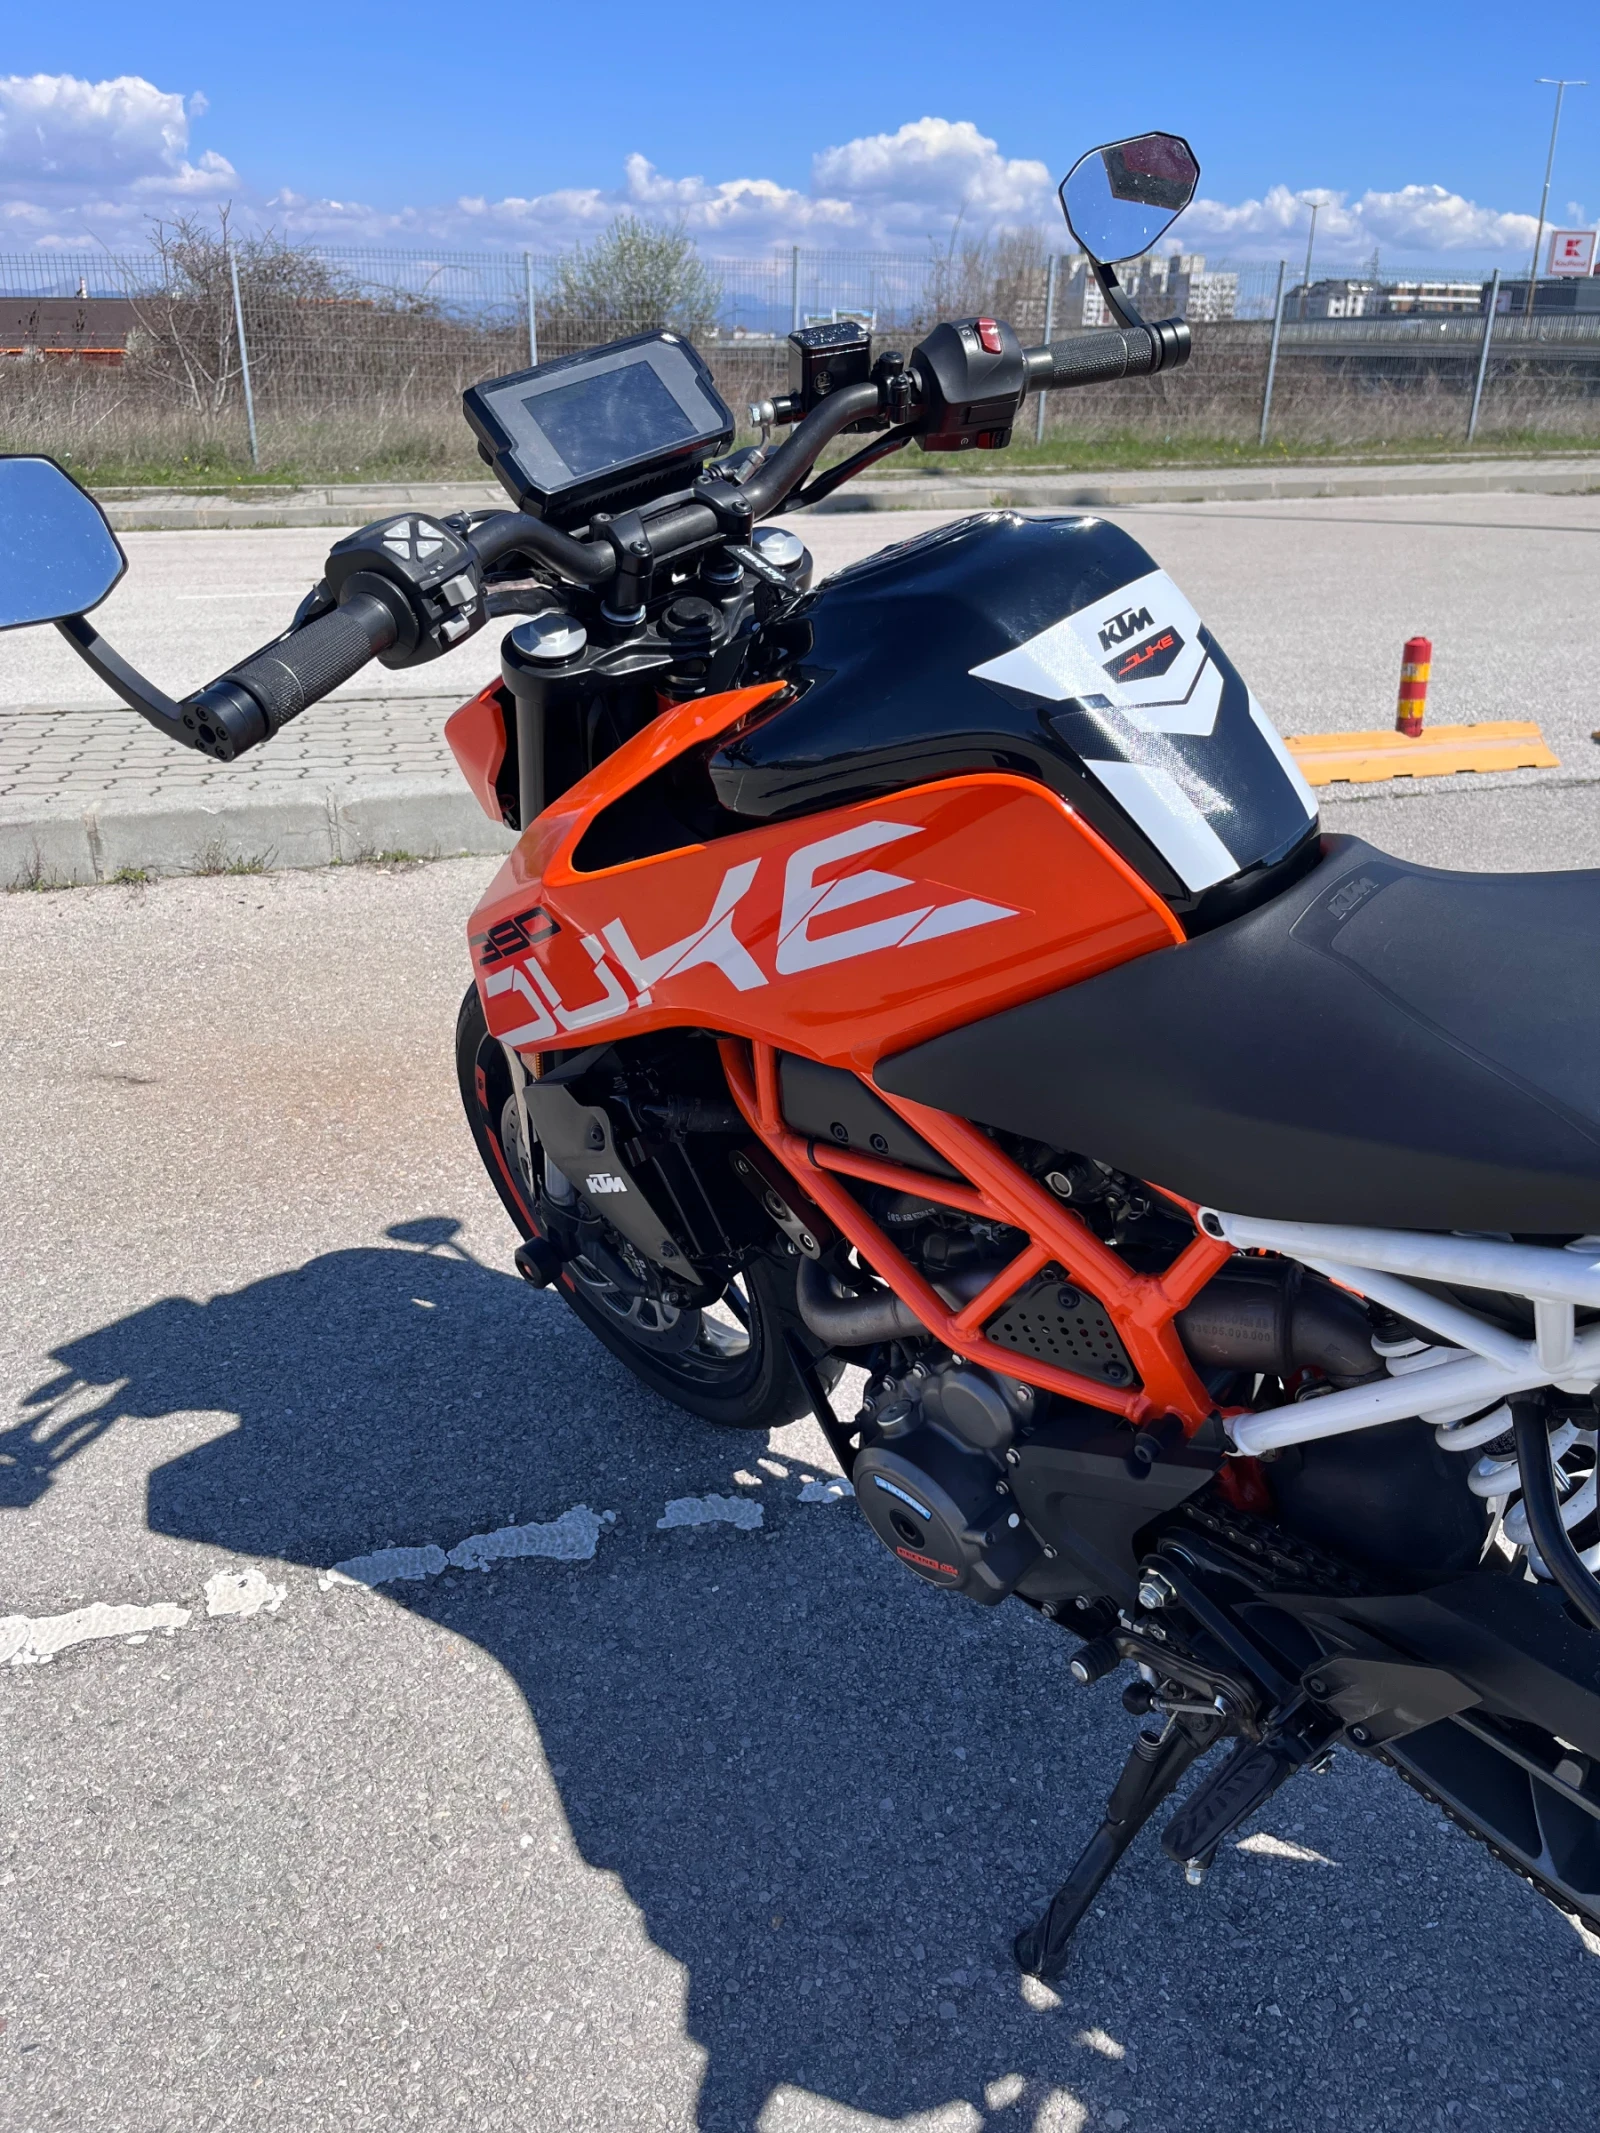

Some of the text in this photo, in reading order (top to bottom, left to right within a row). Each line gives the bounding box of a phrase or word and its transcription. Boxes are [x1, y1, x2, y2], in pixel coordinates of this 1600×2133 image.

[1097, 606, 1156, 653] KTM
[1118, 633, 1174, 676] DUKE
[1326, 877, 1379, 920] KTM
[469, 905, 562, 967] 390
[484, 820, 1020, 1047] DUKE
[585, 1173, 628, 1194] KTM
